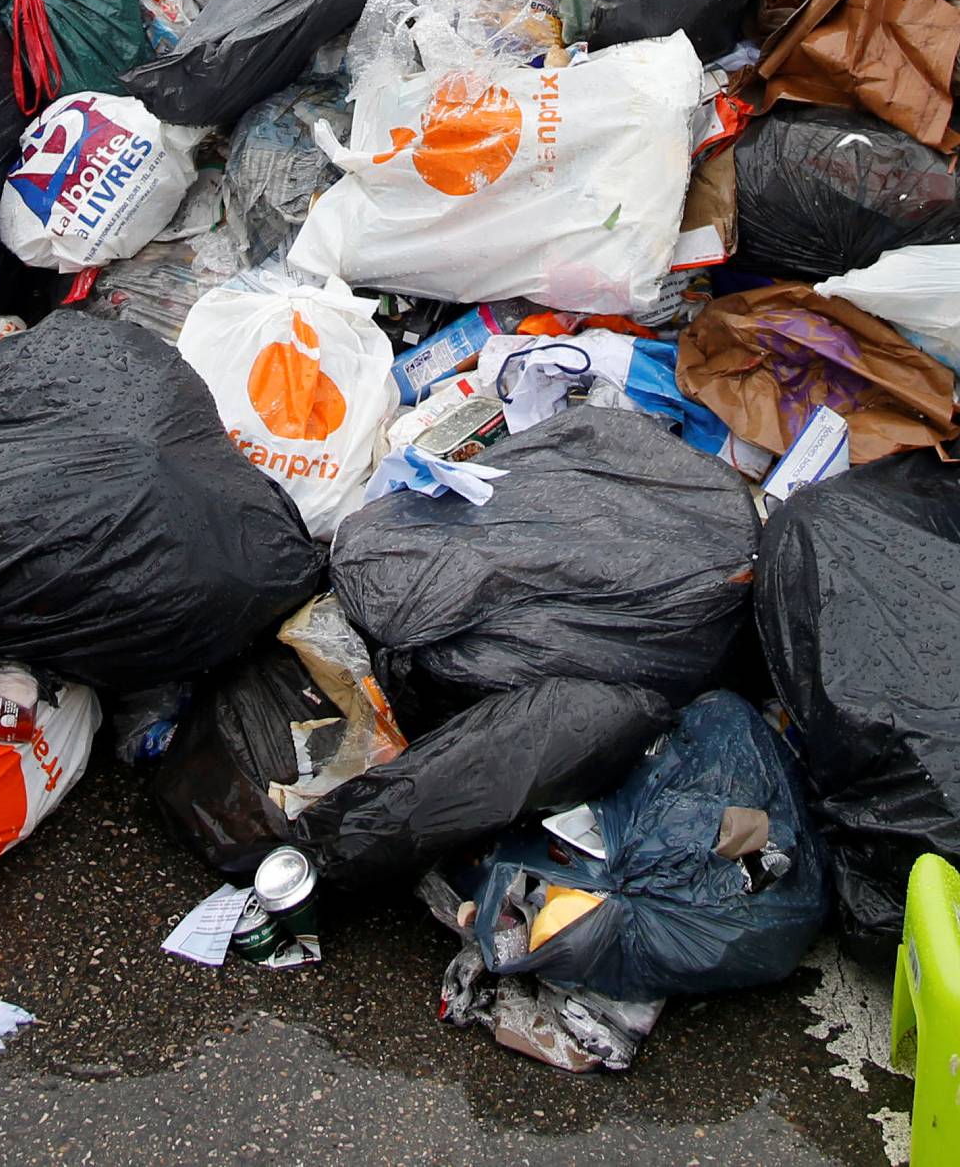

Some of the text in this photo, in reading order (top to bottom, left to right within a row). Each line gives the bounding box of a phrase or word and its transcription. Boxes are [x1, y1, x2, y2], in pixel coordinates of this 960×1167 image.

[51, 132, 129, 237] La boîte
[78, 135, 153, 229] LIVRES
[92, 217, 119, 247] NATIONALE
